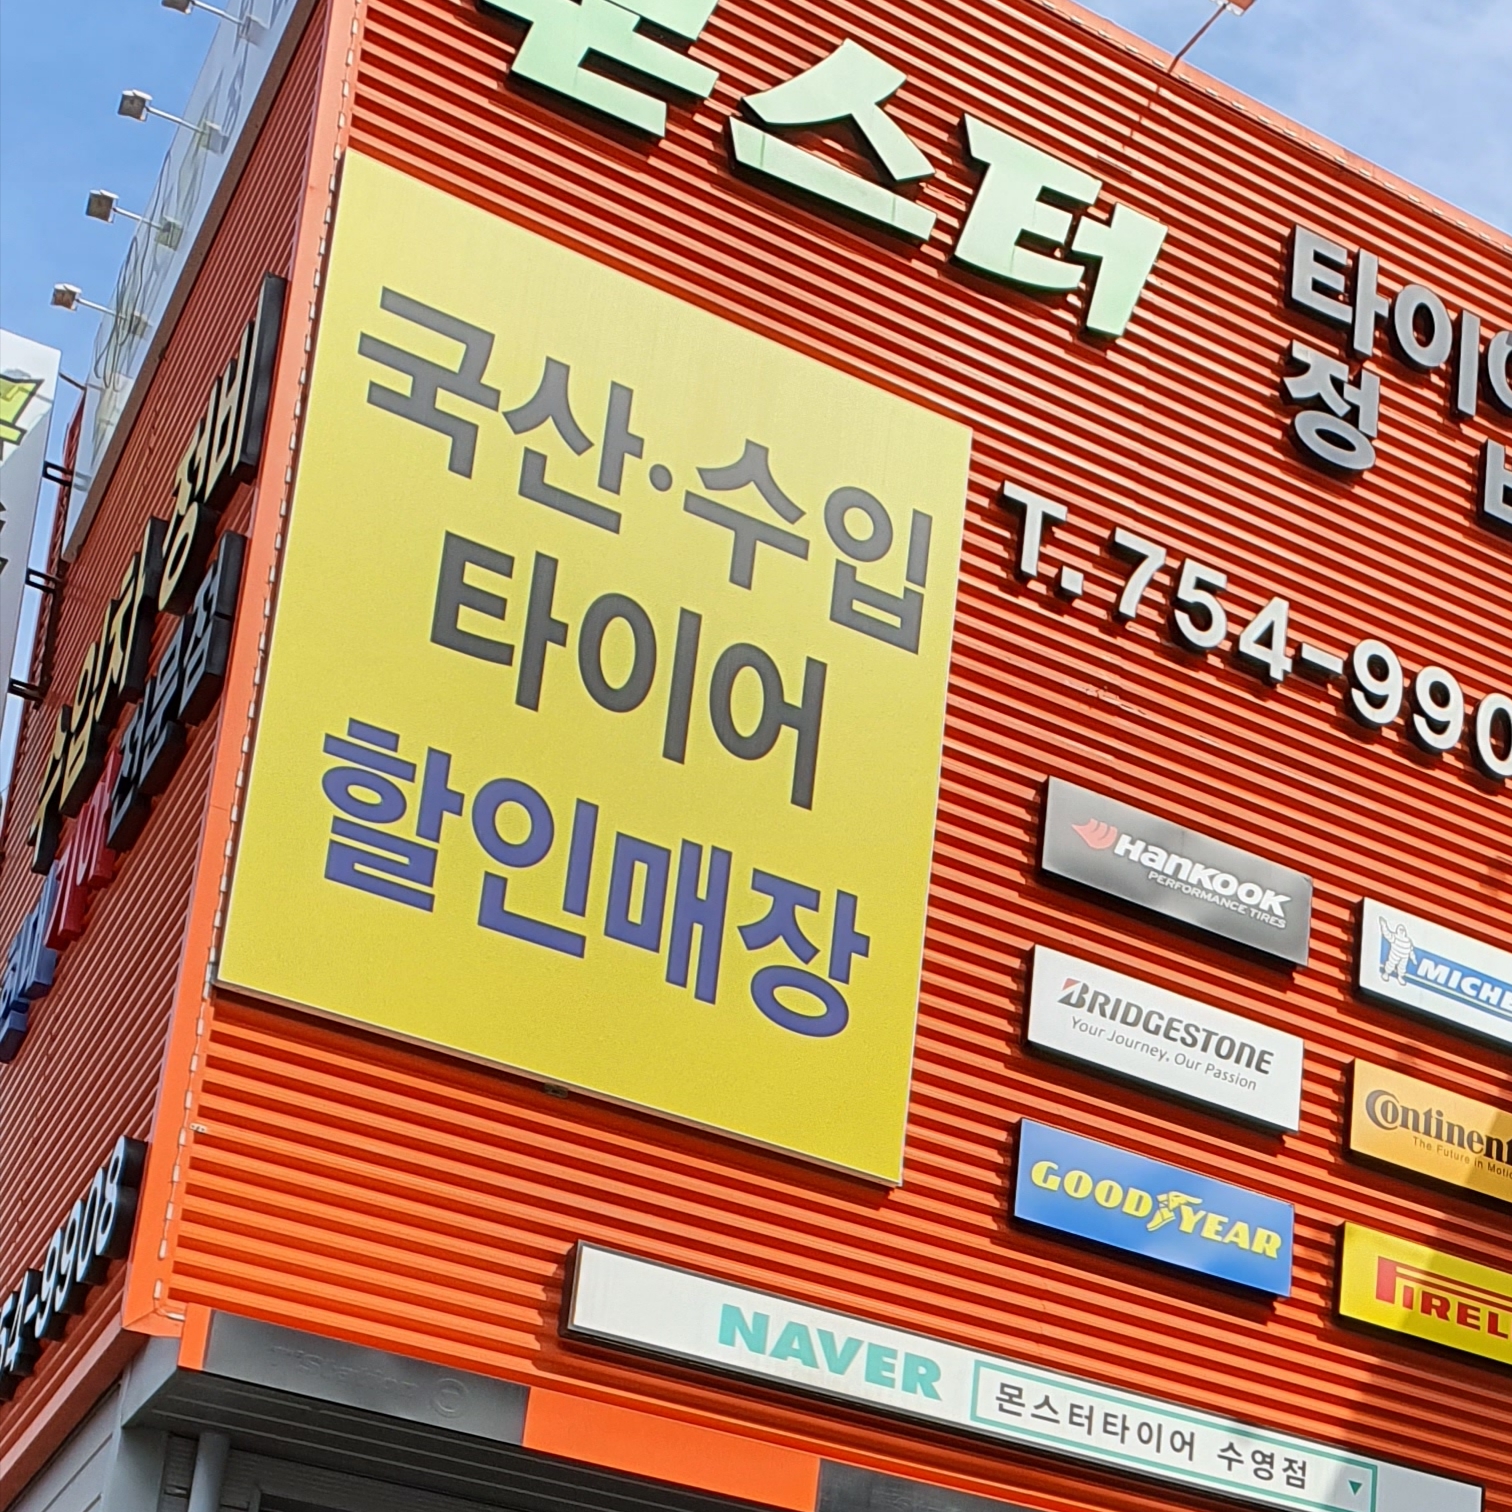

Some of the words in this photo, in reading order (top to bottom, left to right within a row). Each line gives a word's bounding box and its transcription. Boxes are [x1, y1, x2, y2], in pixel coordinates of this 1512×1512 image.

[357, 286, 932, 655] 국산·수입
[430, 531, 827, 811] 타이어
[321, 718, 870, 1038] 할인매장
[1148, 870, 1246, 915] PERFORMANCE
[1249, 908, 1287, 930] TIRES
[1058, 977, 1274, 1075] BRIDGESTONE
[1070, 1015, 1105, 1038] Your
[1174, 1052, 1202, 1072] Our
[1204, 1063, 1258, 1091] Passion
[1412, 1135, 1432, 1151] The
[1436, 1144, 1470, 1165] Future
[1474, 1157, 1483, 1170] in
[1030, 1160, 1283, 1259] GOODYEAR
[718, 1303, 942, 1400] NAVER
[995, 1381, 1196, 1462] 몬스터타이어
[1216, 1441, 1309, 1490] 수영점
